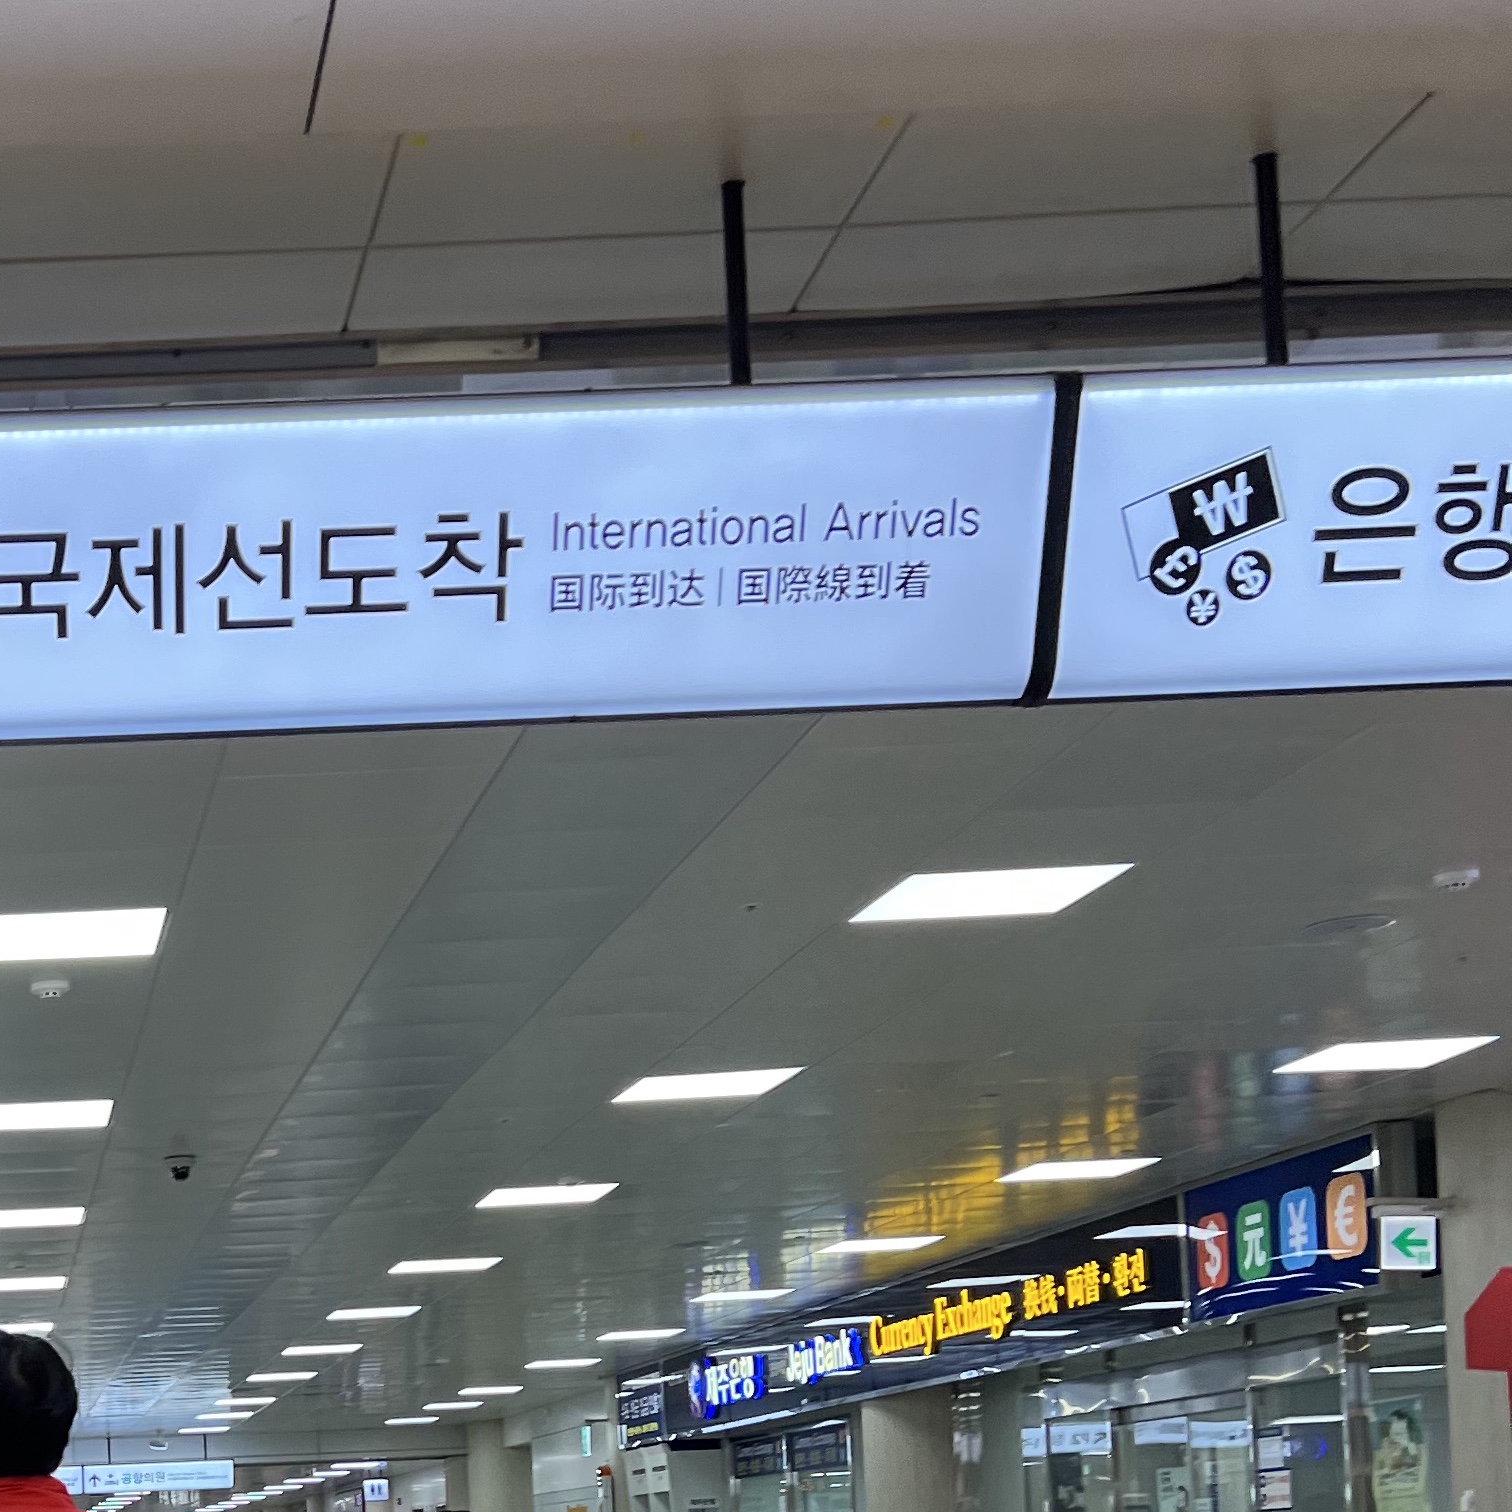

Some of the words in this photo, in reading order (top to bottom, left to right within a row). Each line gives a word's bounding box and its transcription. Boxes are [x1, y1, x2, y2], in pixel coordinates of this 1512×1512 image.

[551, 503, 807, 552] International
[823, 498, 980, 541] Arrivals
[1313, 463, 1512, 583] 은행
[549, 568, 706, 613] 国际到达
[736, 560, 931, 607] 国際線到着
[705, 1354, 757, 1407] 제주은행
[786, 1341, 815, 1385] Jeju
[814, 1328, 855, 1376] Bank
[869, 1314, 934, 1356] Currency
[933, 1288, 1013, 1340] Exchange
